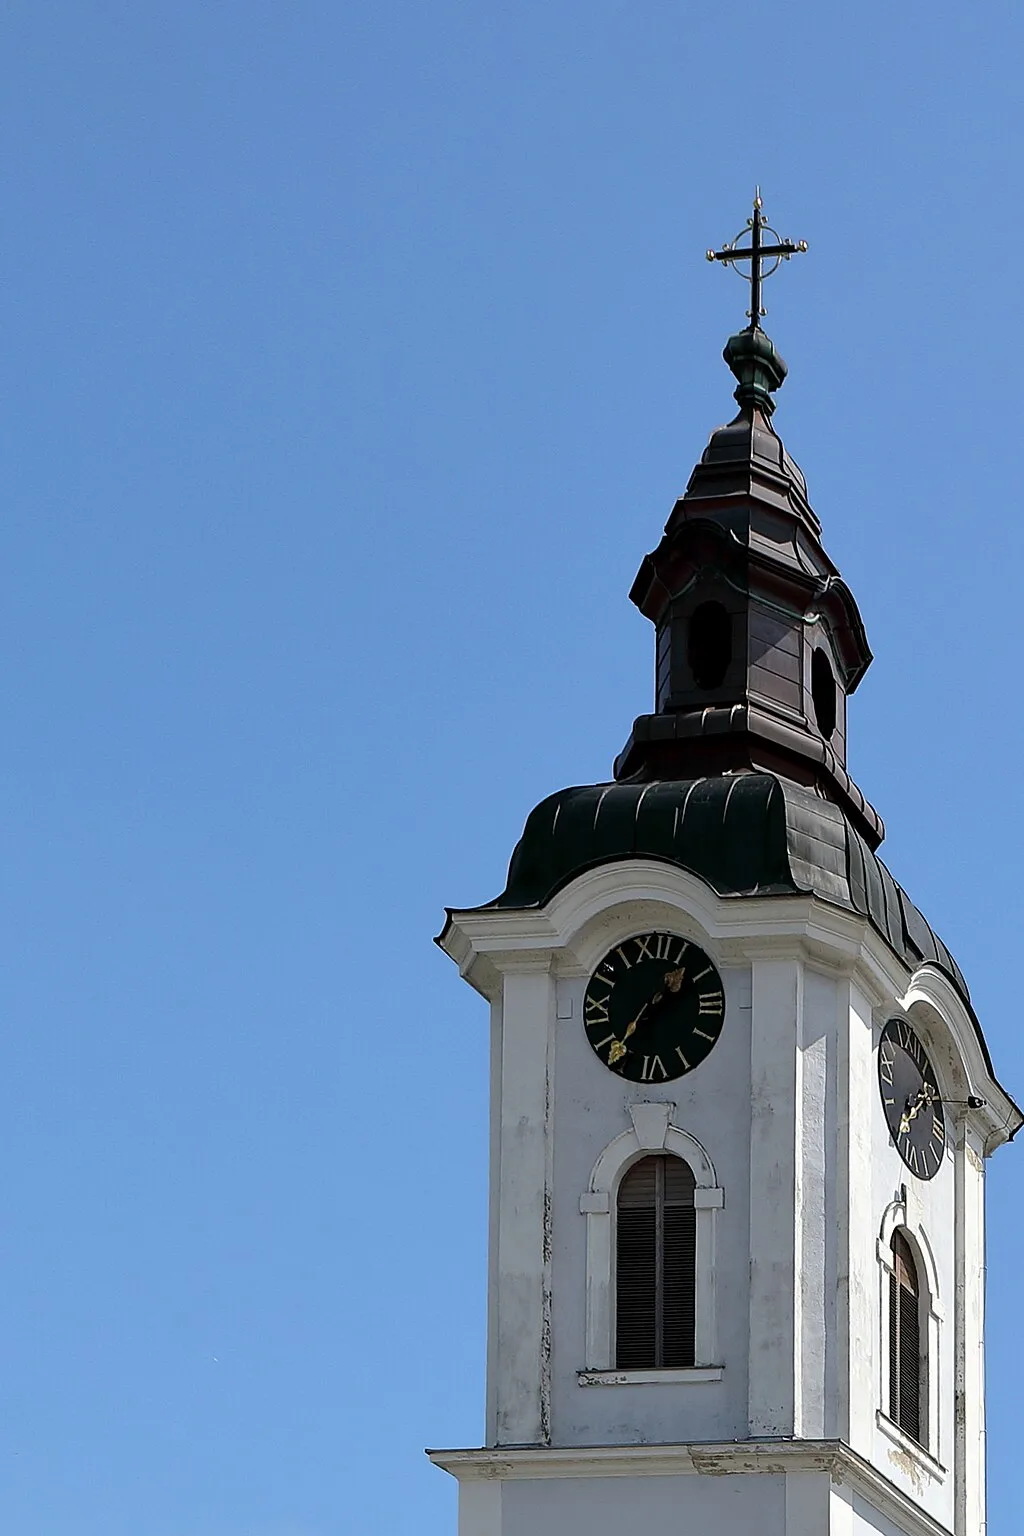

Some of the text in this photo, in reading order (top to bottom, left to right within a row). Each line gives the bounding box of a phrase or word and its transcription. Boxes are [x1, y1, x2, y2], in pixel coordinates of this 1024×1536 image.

[633, 935, 673, 964] XII
[585, 994, 610, 1026] IX
[698, 991, 723, 1016] III
[640, 1055, 669, 1081] VI
